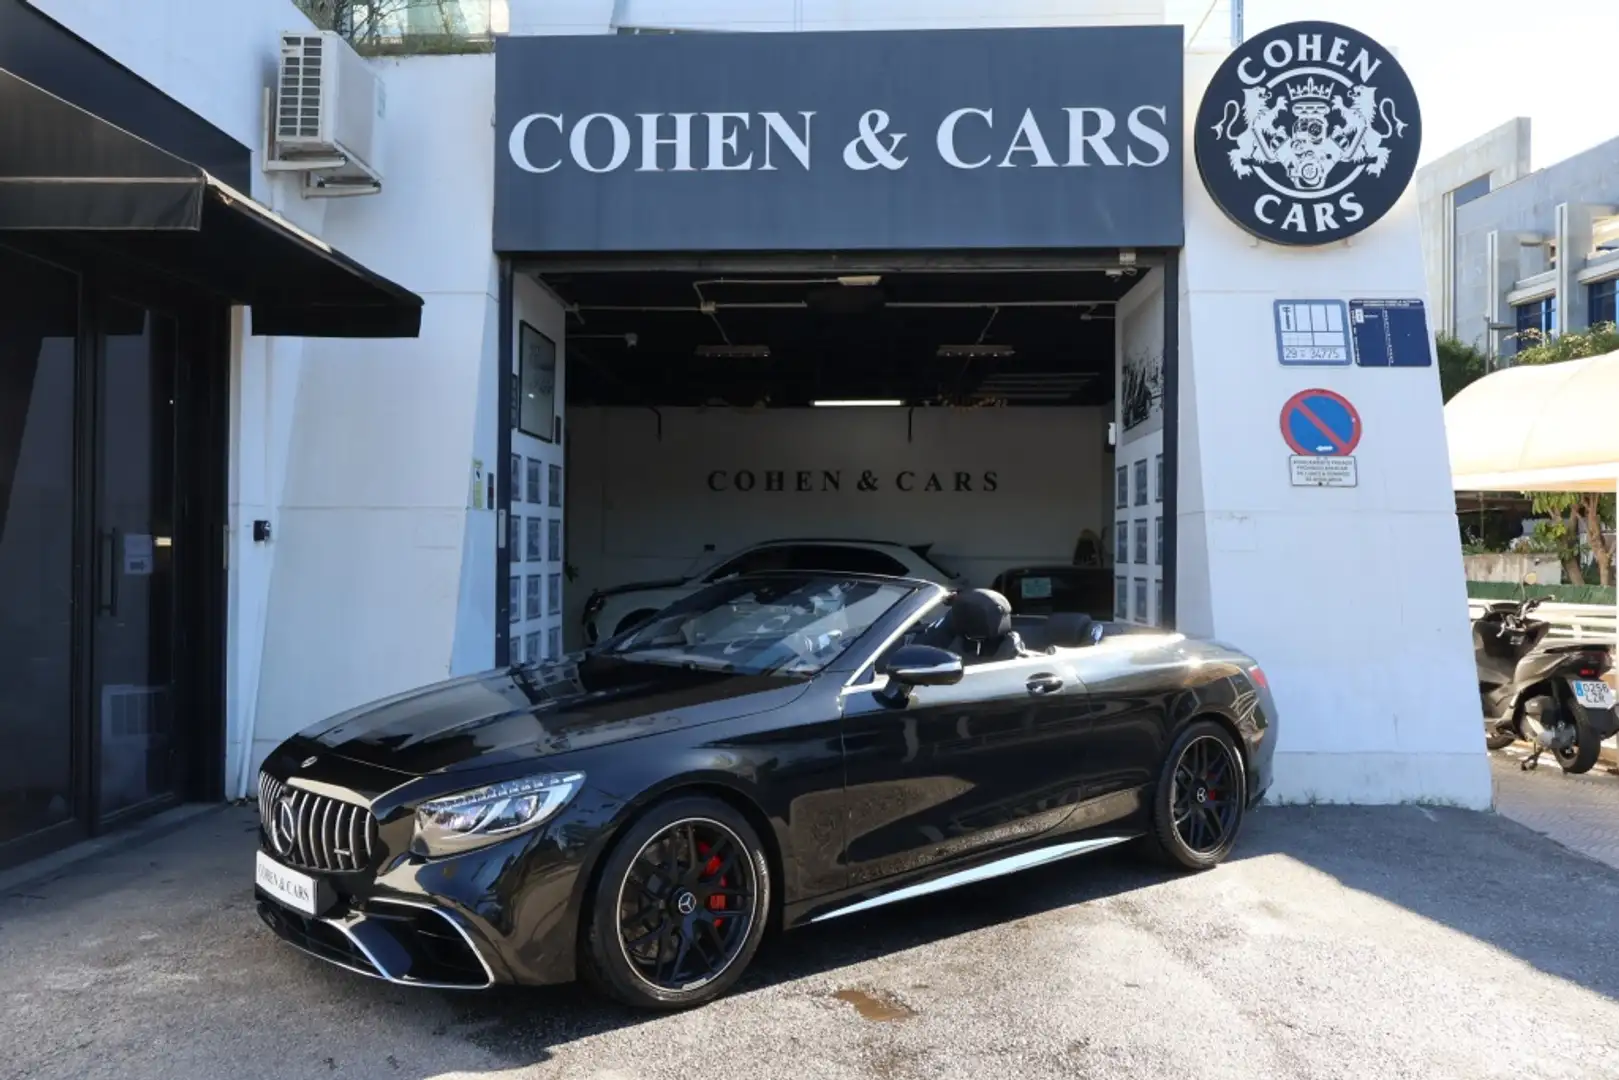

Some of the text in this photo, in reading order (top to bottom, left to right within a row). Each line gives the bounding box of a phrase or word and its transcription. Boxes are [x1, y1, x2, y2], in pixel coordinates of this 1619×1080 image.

[1237, 34, 1382, 85] COHEN
[508, 105, 1171, 173] COHEN & CARS
[1253, 191, 1364, 233] CARS
[707, 469, 999, 493] COHEN & CARS
[258, 863, 278, 887] COHEN
[286, 880, 310, 901] CARS
